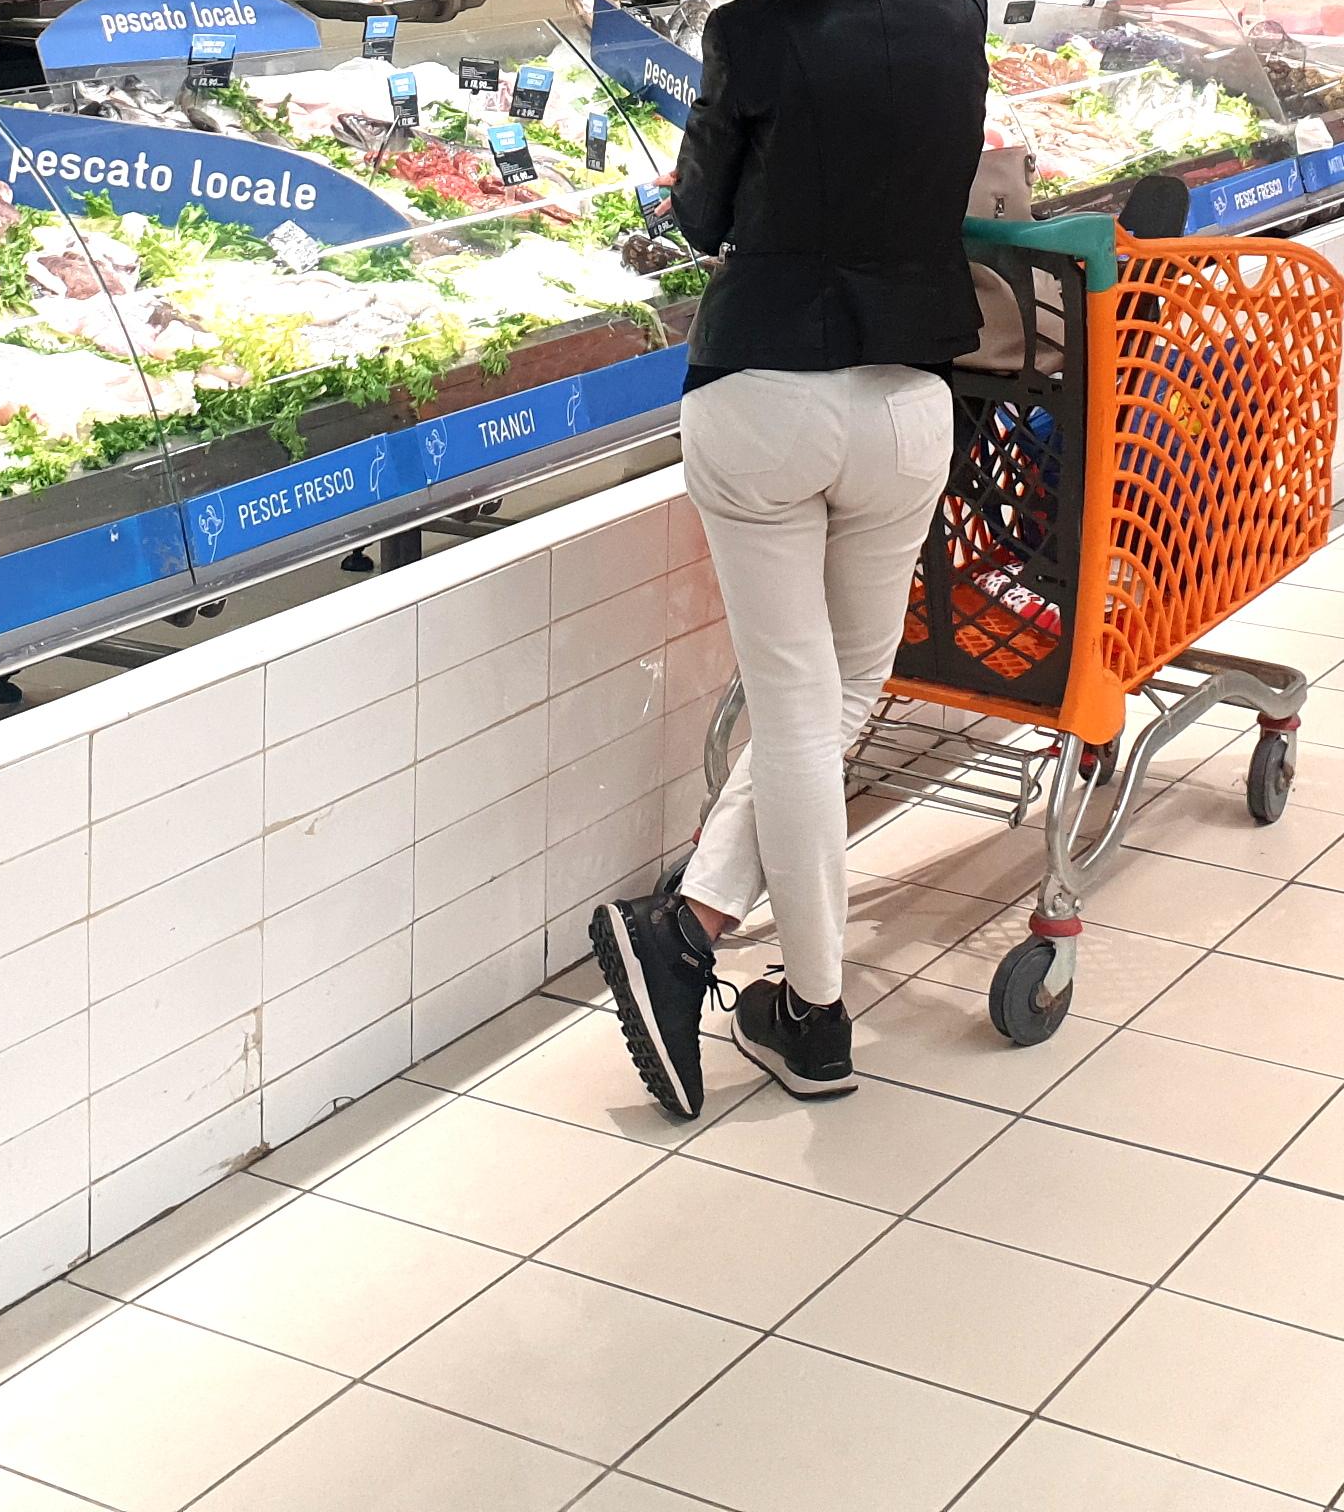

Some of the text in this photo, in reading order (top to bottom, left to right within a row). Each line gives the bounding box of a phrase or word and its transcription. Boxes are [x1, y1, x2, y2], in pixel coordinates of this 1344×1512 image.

[101, 0, 257, 42] pescato locale
[643, 57, 696, 108] pescato
[8, 145, 317, 211] pescato locale
[1234, 178, 1283, 211] PESCE FRESCO
[477, 407, 537, 448] TRANCI
[237, 467, 355, 530] PESCE FRESCO
